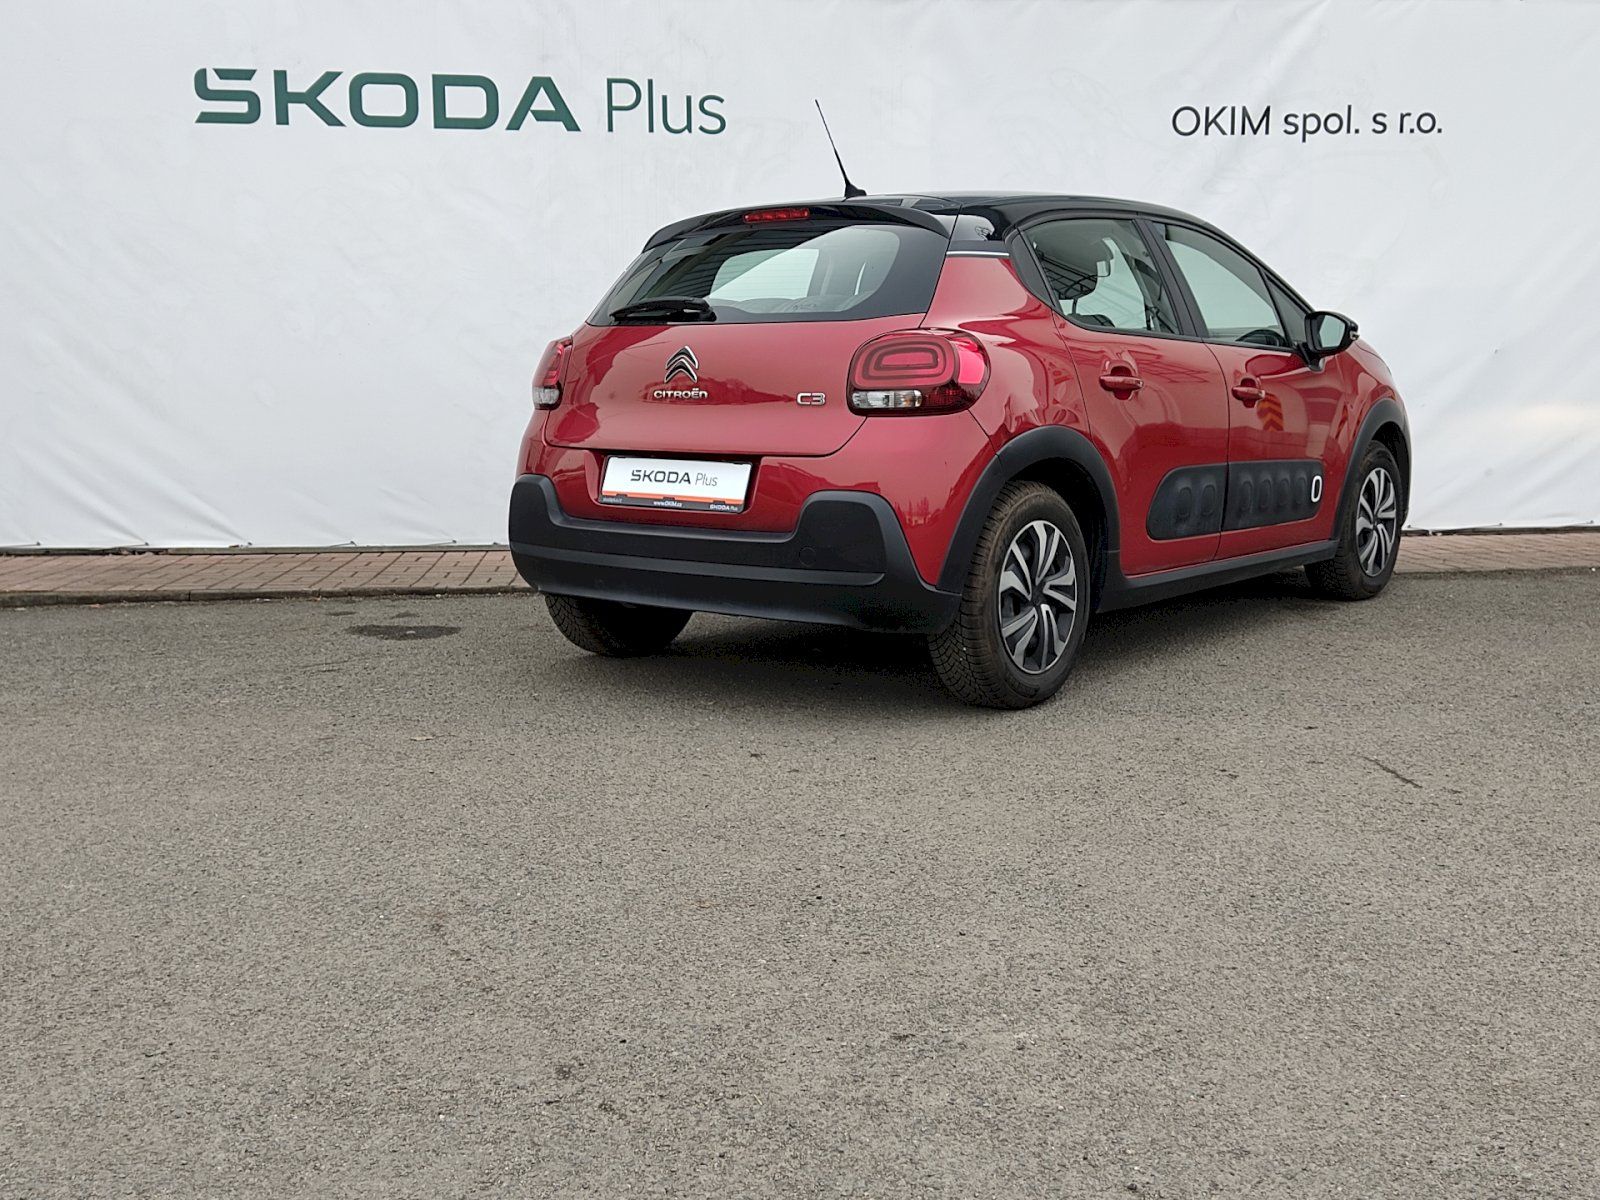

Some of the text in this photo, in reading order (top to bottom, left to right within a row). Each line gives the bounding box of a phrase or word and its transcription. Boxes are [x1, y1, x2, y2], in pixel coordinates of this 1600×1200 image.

[606, 77, 728, 135] Plus
[1172, 104, 1443, 143] OKIM spol. s r.o.
[797, 393, 825, 405] C3
[695, 473, 718, 487] Plus
